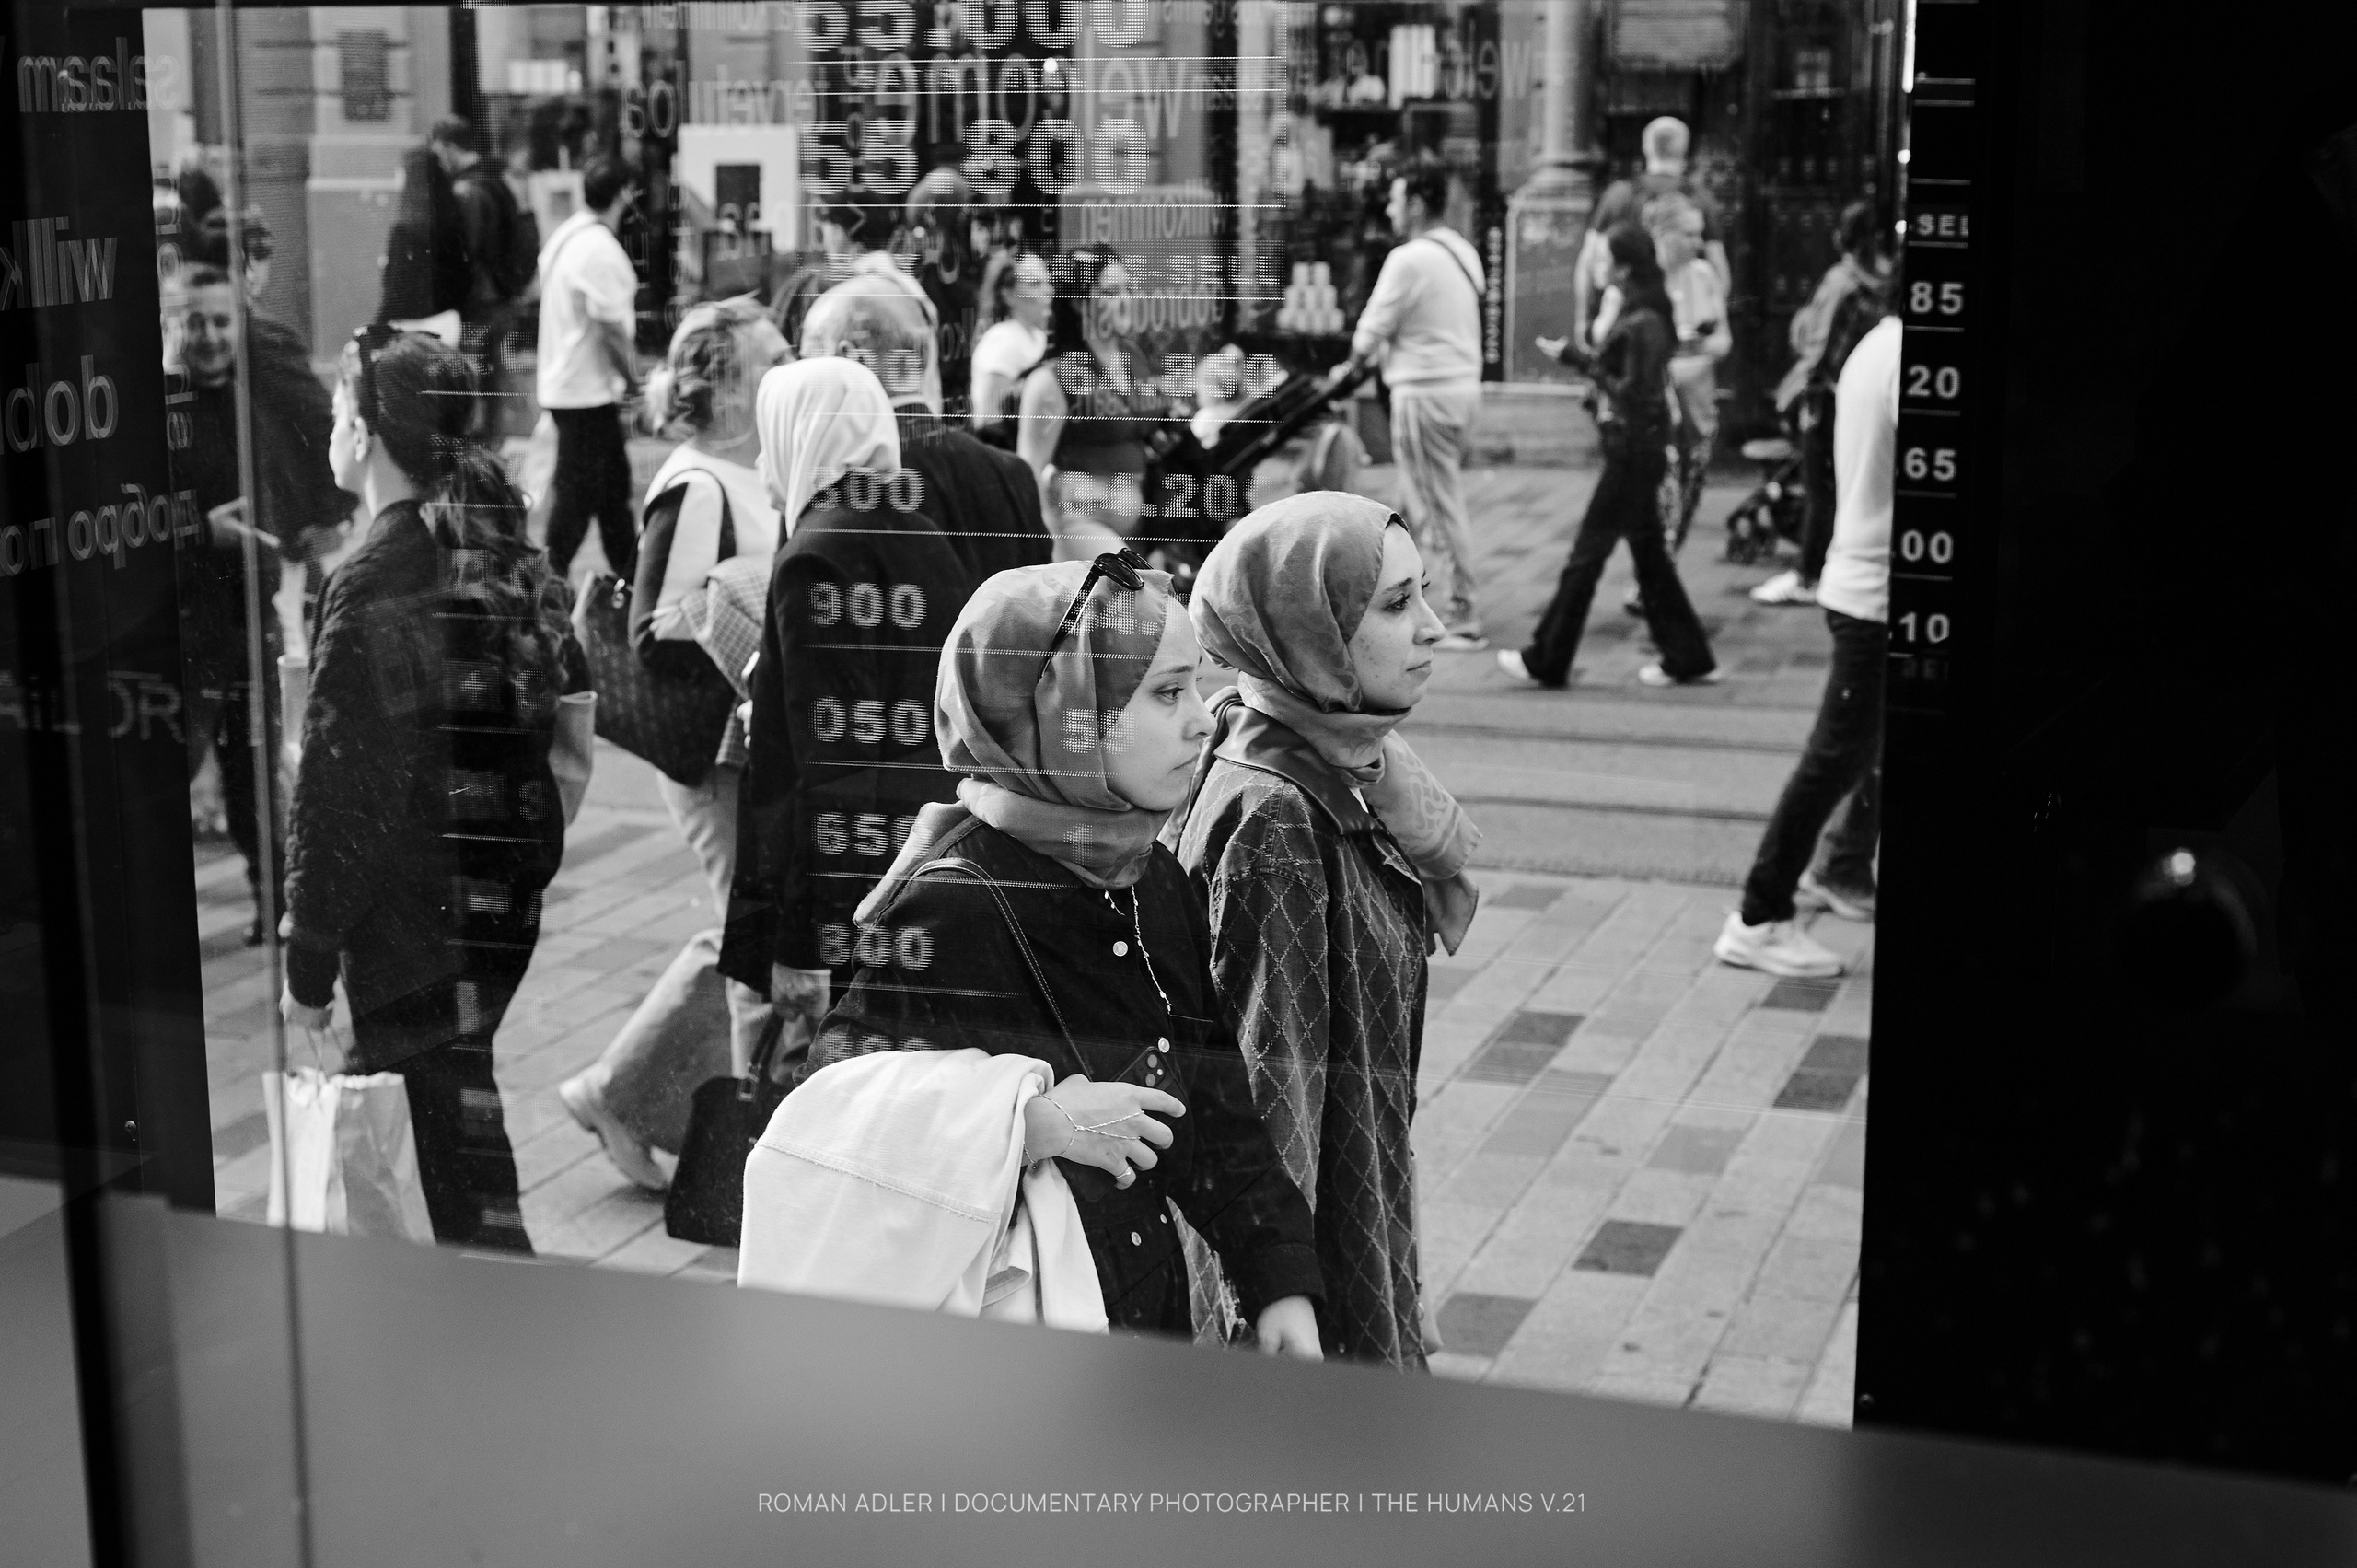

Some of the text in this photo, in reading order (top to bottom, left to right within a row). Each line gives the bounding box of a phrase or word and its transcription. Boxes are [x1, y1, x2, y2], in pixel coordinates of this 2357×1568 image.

[797, 117, 1151, 196] 55.800
[1905, 363, 1961, 400] 20
[804, 581, 928, 631] 900
[807, 694, 930, 747] 050
[815, 923, 935, 972] 800
